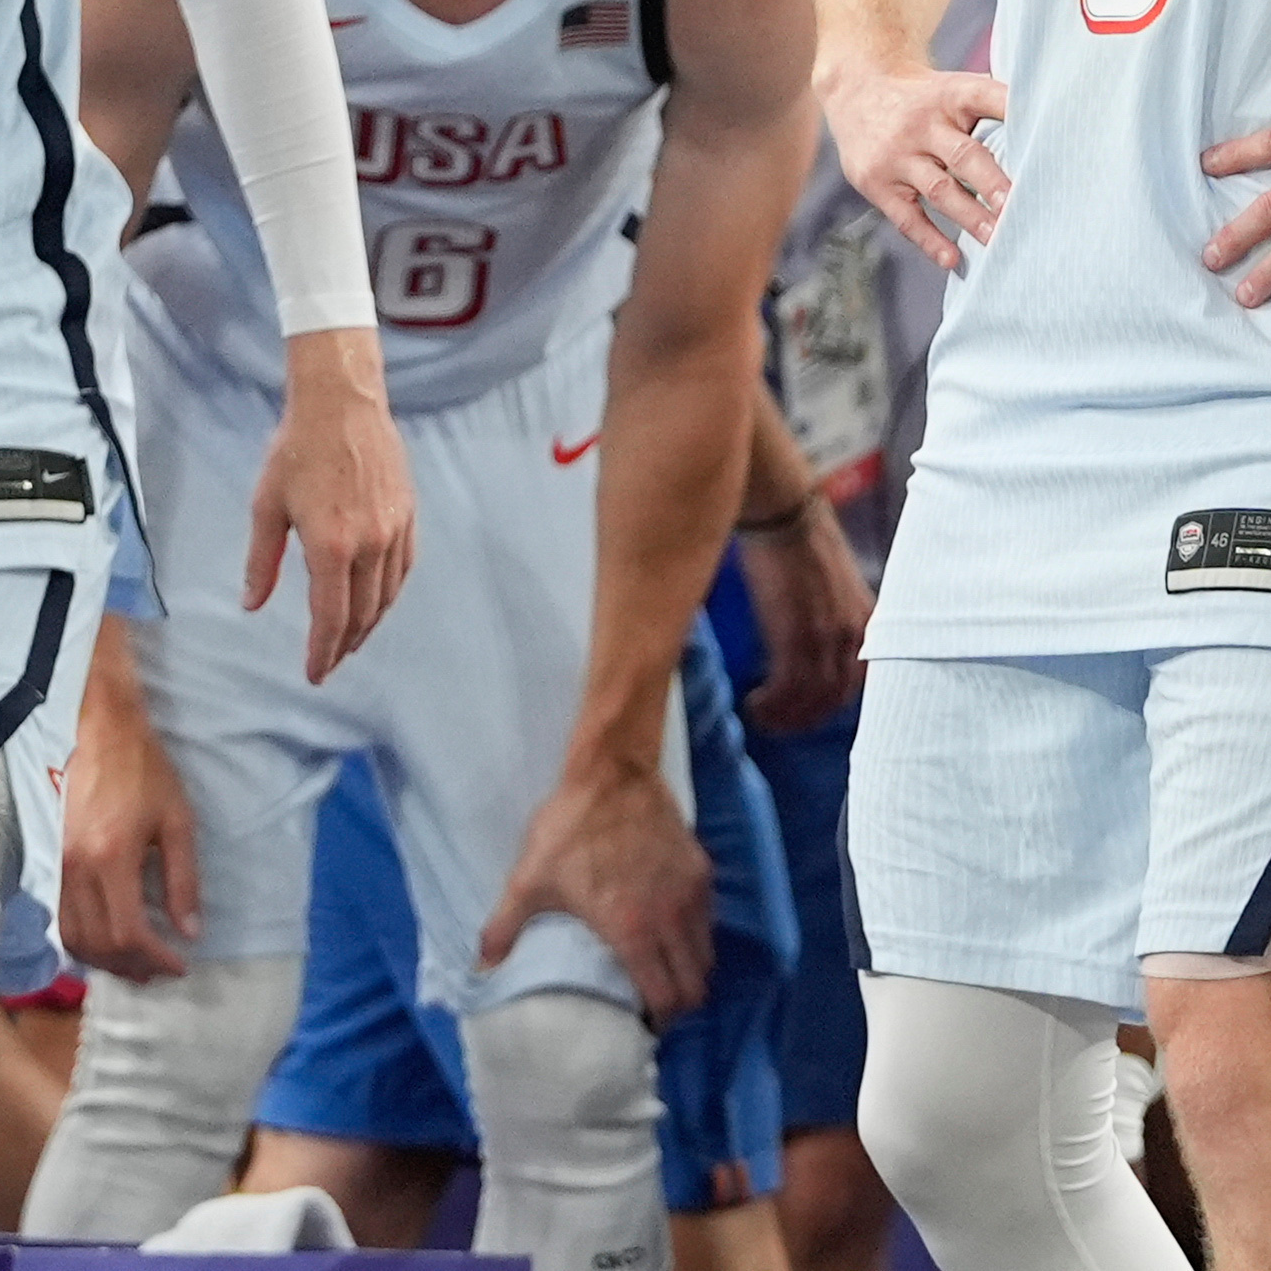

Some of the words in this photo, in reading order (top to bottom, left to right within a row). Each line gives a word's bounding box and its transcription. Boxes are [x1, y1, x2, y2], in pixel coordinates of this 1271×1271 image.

[350, 102, 568, 186] USA
[370, 218, 498, 328] 6
[1210, 532, 1230, 548] 46
